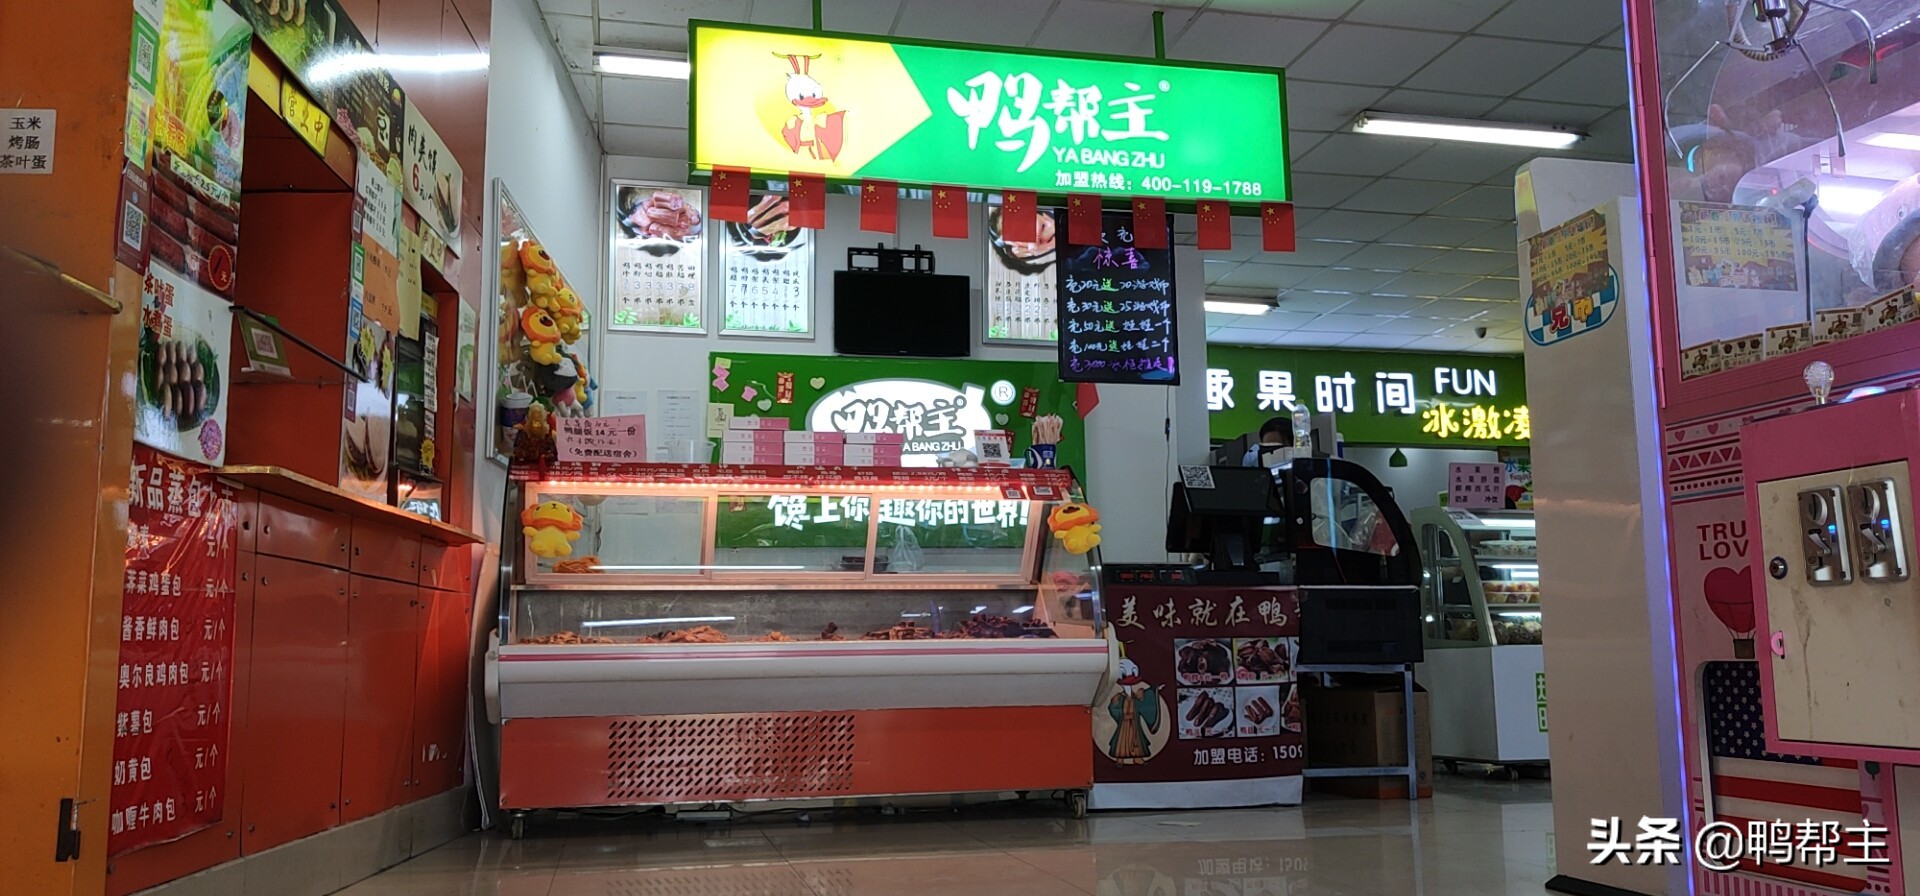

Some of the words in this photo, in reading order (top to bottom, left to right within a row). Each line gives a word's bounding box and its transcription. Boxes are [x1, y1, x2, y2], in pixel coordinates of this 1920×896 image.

[10, 116, 41, 131] 玉米
[947, 70, 1170, 173] 鸭帮主
[8, 135, 40, 151] 烤肠
[1052, 146, 1079, 164] YA
[1081, 148, 1130, 167] BANG
[1131, 151, 1165, 169] ZHU
[0, 154, 46, 170] 茶叶蛋
[1093, 247, 1139, 270] 惊喜
[144, 273, 174, 307] 茶叶蛋
[143, 306, 172, 338] 水煮蛋
[1434, 367, 1496, 396] FUN
[1422, 404, 1530, 440] 冰激凌
[128, 459, 201, 518] 新品蒸包
[768, 494, 1030, 531] 馋上你趣你的世界!
[205, 577, 229, 598] 元/个
[203, 617, 226, 640] 元/个
[1117, 595, 1301, 630] 美味就在鸭
[119, 661, 189, 689] 奥尔良鸡肉包
[200, 659, 223, 683] 元/个
[116, 708, 153, 738] 紫薯包
[197, 701, 221, 726] 元/个
[113, 756, 152, 786] 奶黄包
[194, 743, 218, 770] 元/个
[111, 797, 176, 835] 咖喱牛肉包
[194, 785, 217, 813] 元/个
